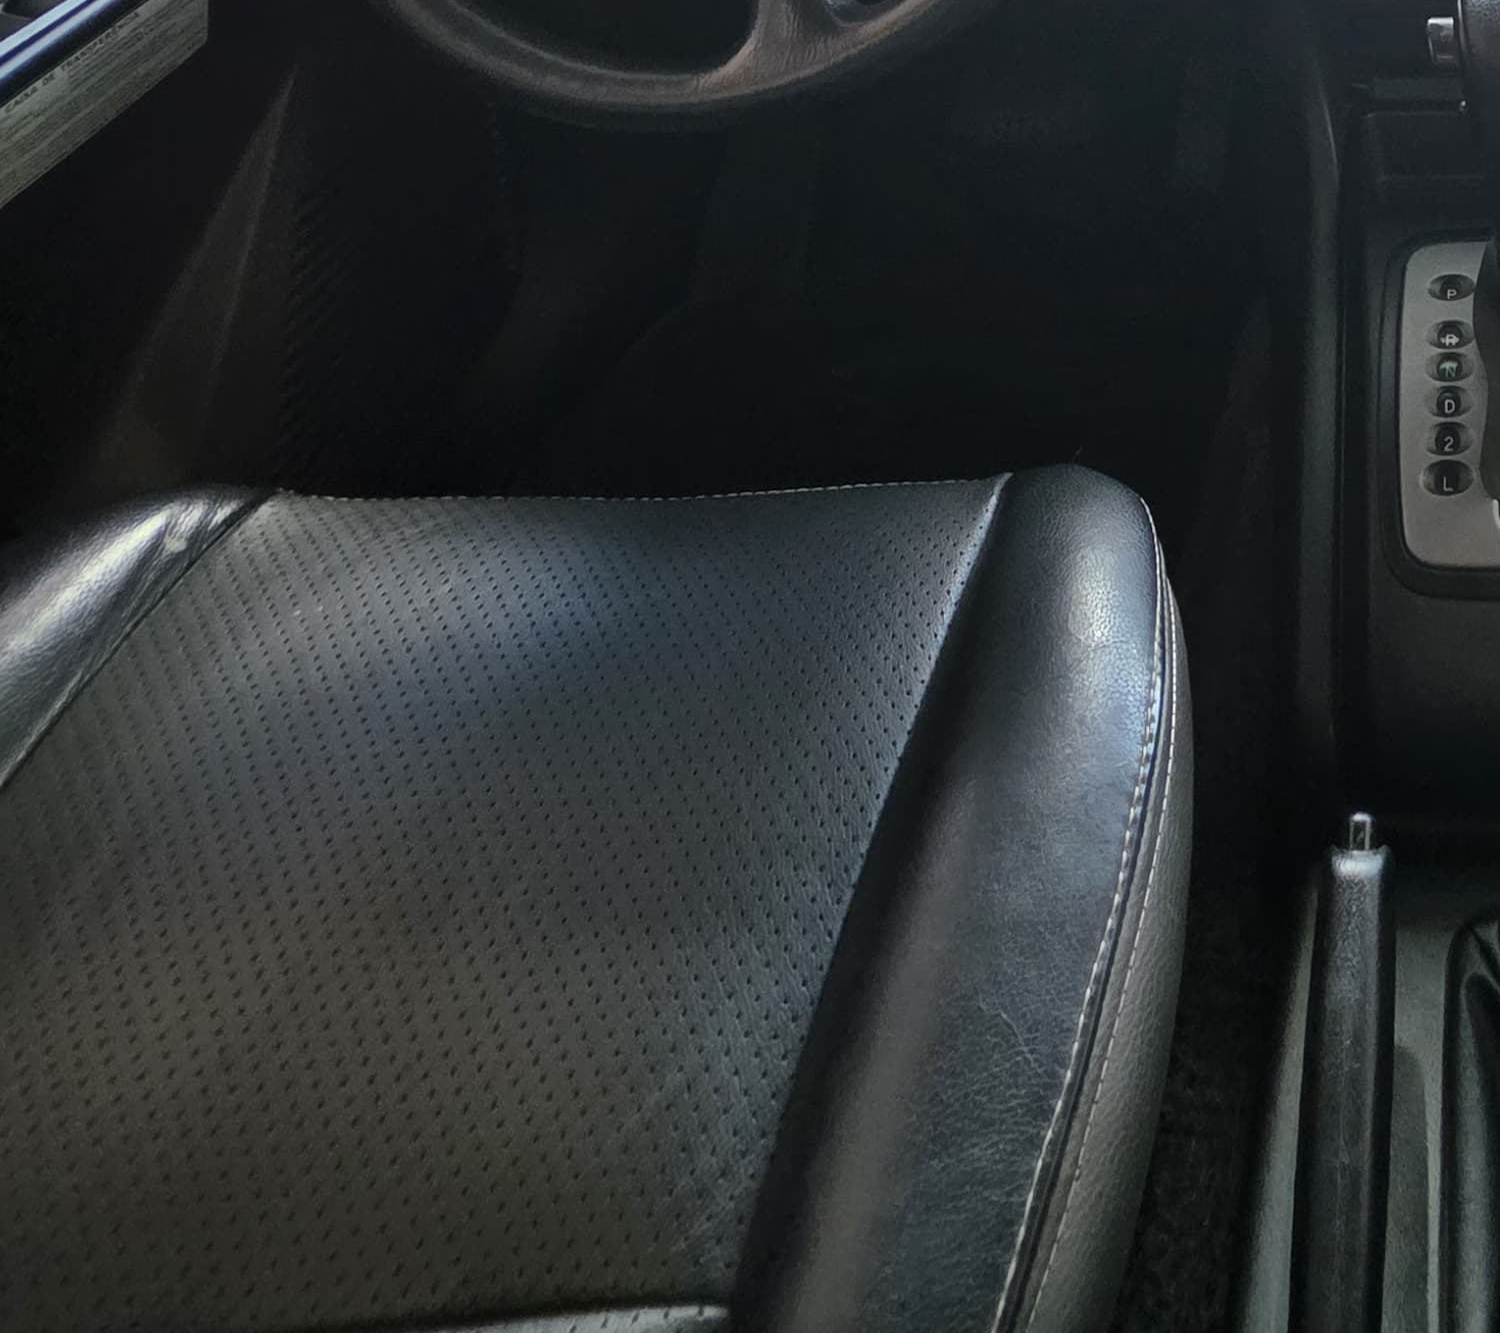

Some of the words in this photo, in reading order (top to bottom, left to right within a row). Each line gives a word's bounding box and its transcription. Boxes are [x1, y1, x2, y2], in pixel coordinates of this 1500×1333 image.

[1447, 288, 1457, 299] P
[1444, 399, 1455, 413] D
[1444, 436, 1454, 452] 2
[1443, 476, 1454, 492] L
